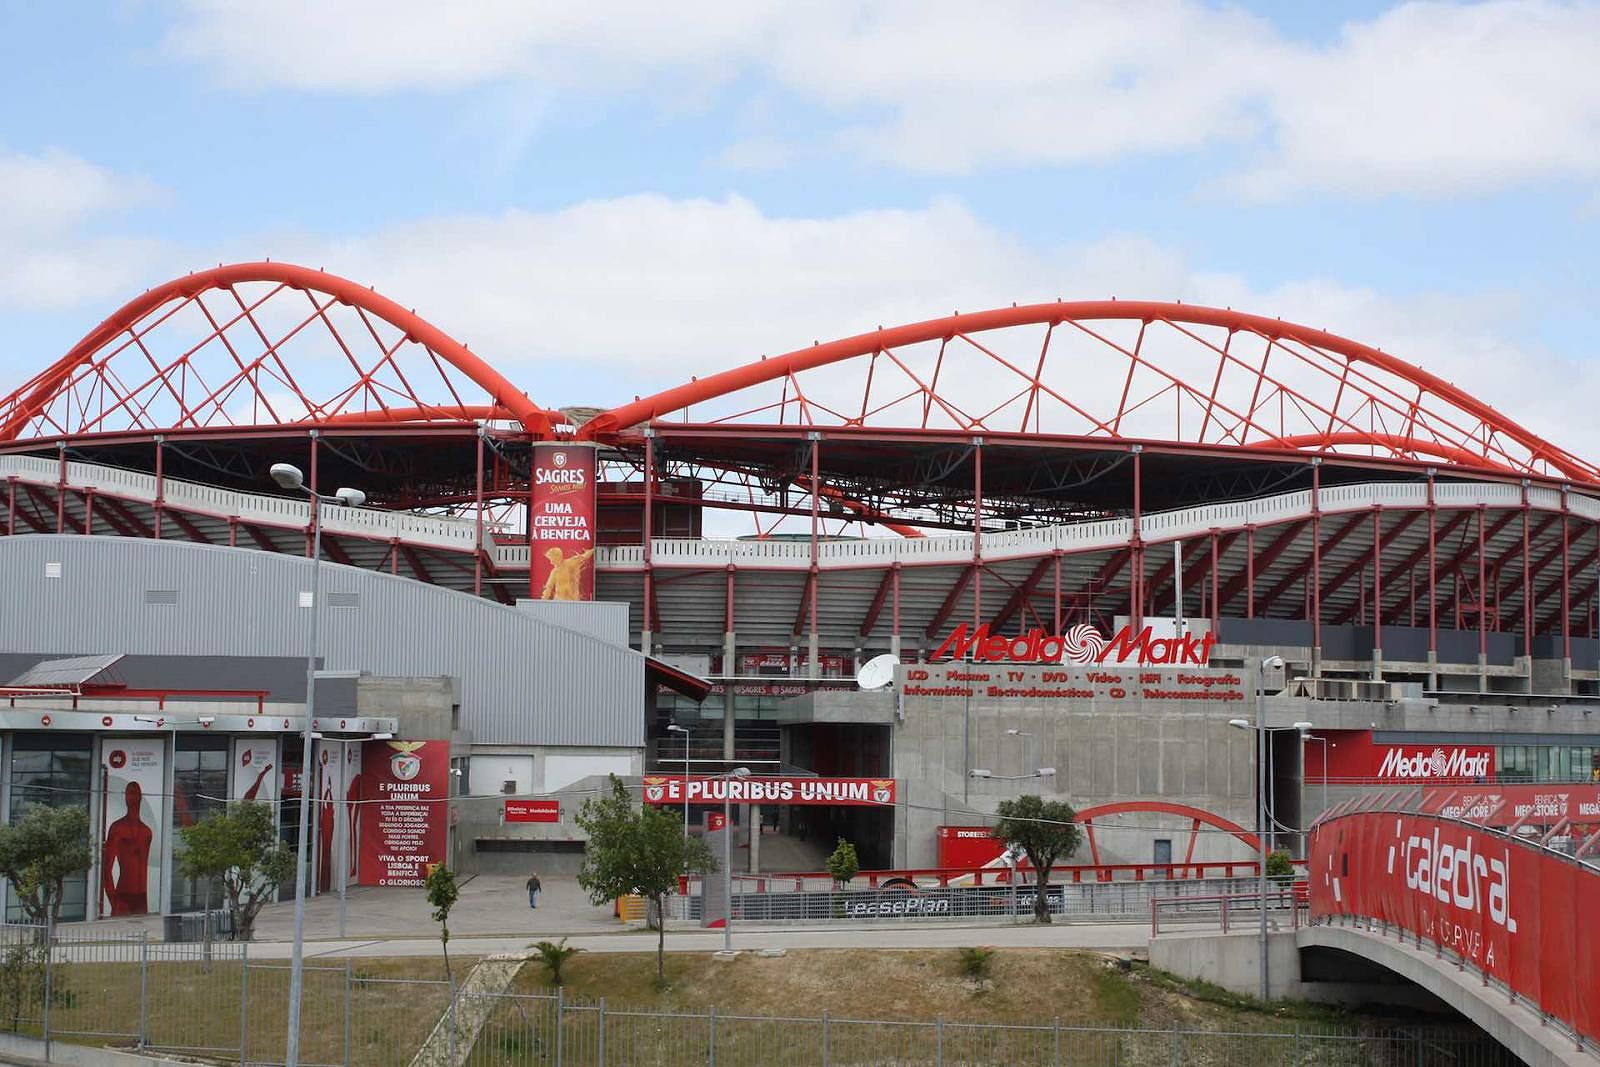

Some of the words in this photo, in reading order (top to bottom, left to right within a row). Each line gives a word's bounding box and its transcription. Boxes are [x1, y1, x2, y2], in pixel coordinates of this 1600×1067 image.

[536, 468, 585, 484] SAGRES
[545, 503, 573, 513] UMA
[535, 516, 587, 527] CERVEJA
[531, 527, 538, 539] À
[541, 529, 590, 540] BENFICA
[930, 623, 1065, 663] Media
[1097, 625, 1216, 664] Markt
[907, 671, 929, 681] LCD
[946, 671, 990, 682] Plasma
[1007, 672, 1024, 682] TV
[1042, 672, 1068, 683] DVD
[1177, 674, 1240, 688] Fotografia
[741, 686, 766, 695] SAGRES
[781, 686, 806, 695] SAGRES
[1109, 688, 1126, 698] CD
[1377, 748, 1432, 777] Media
[1443, 748, 1489, 777] Markt
[379, 783, 385, 791] E
[387, 783, 431, 792] PLURIBUS
[669, 781, 680, 799] E
[688, 781, 793, 800] PLURIBUS
[801, 783, 868, 801] UNUM
[388, 879, 426, 887] GLORIOSO
[845, 898, 949, 915] LeasePlan
